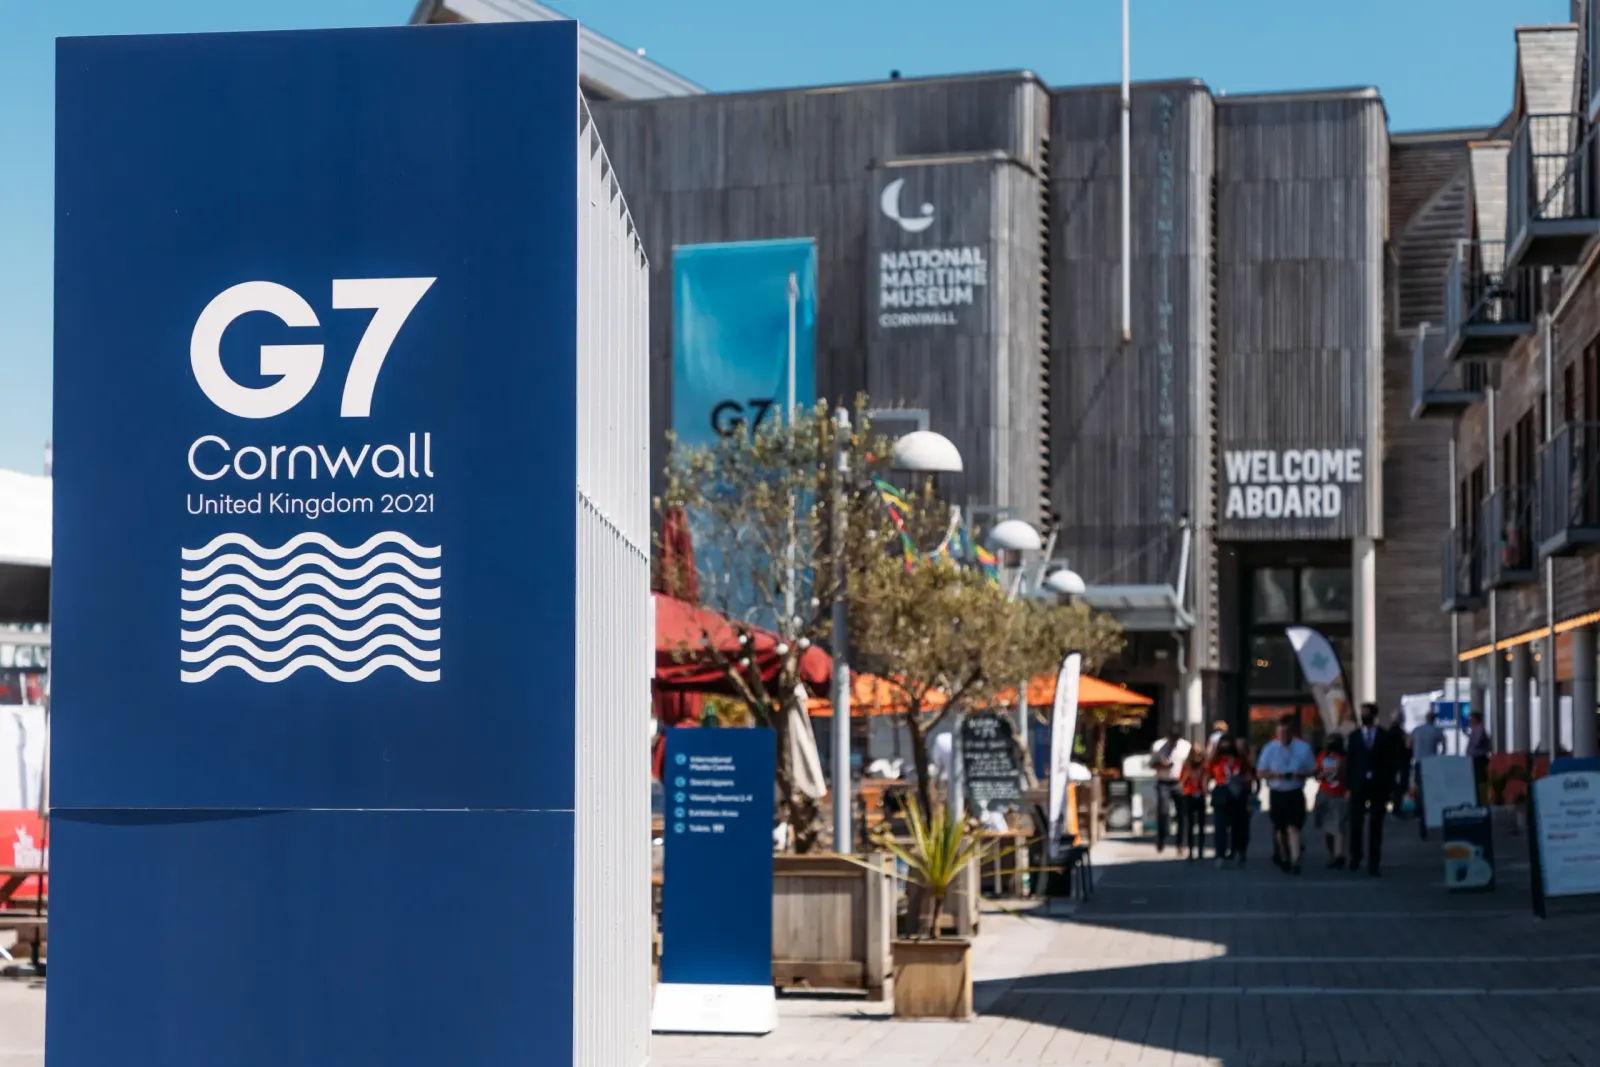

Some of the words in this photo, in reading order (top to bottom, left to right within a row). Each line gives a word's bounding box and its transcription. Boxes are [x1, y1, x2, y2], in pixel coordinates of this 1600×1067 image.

[880, 246, 987, 269] NATIONAL
[880, 265, 988, 288] MARITIME
[880, 285, 973, 308] MUSEUM
[879, 311, 958, 328] CORNWALL
[190, 277, 437, 418] G7
[711, 398, 773, 438] G7
[187, 432, 433, 480] Cornwall
[1224, 448, 1363, 483] WELCOME
[187, 493, 262, 514] United
[269, 492, 374, 520] Kingdom
[381, 494, 434, 513] 2021
[1225, 484, 1342, 519] ABOARD
